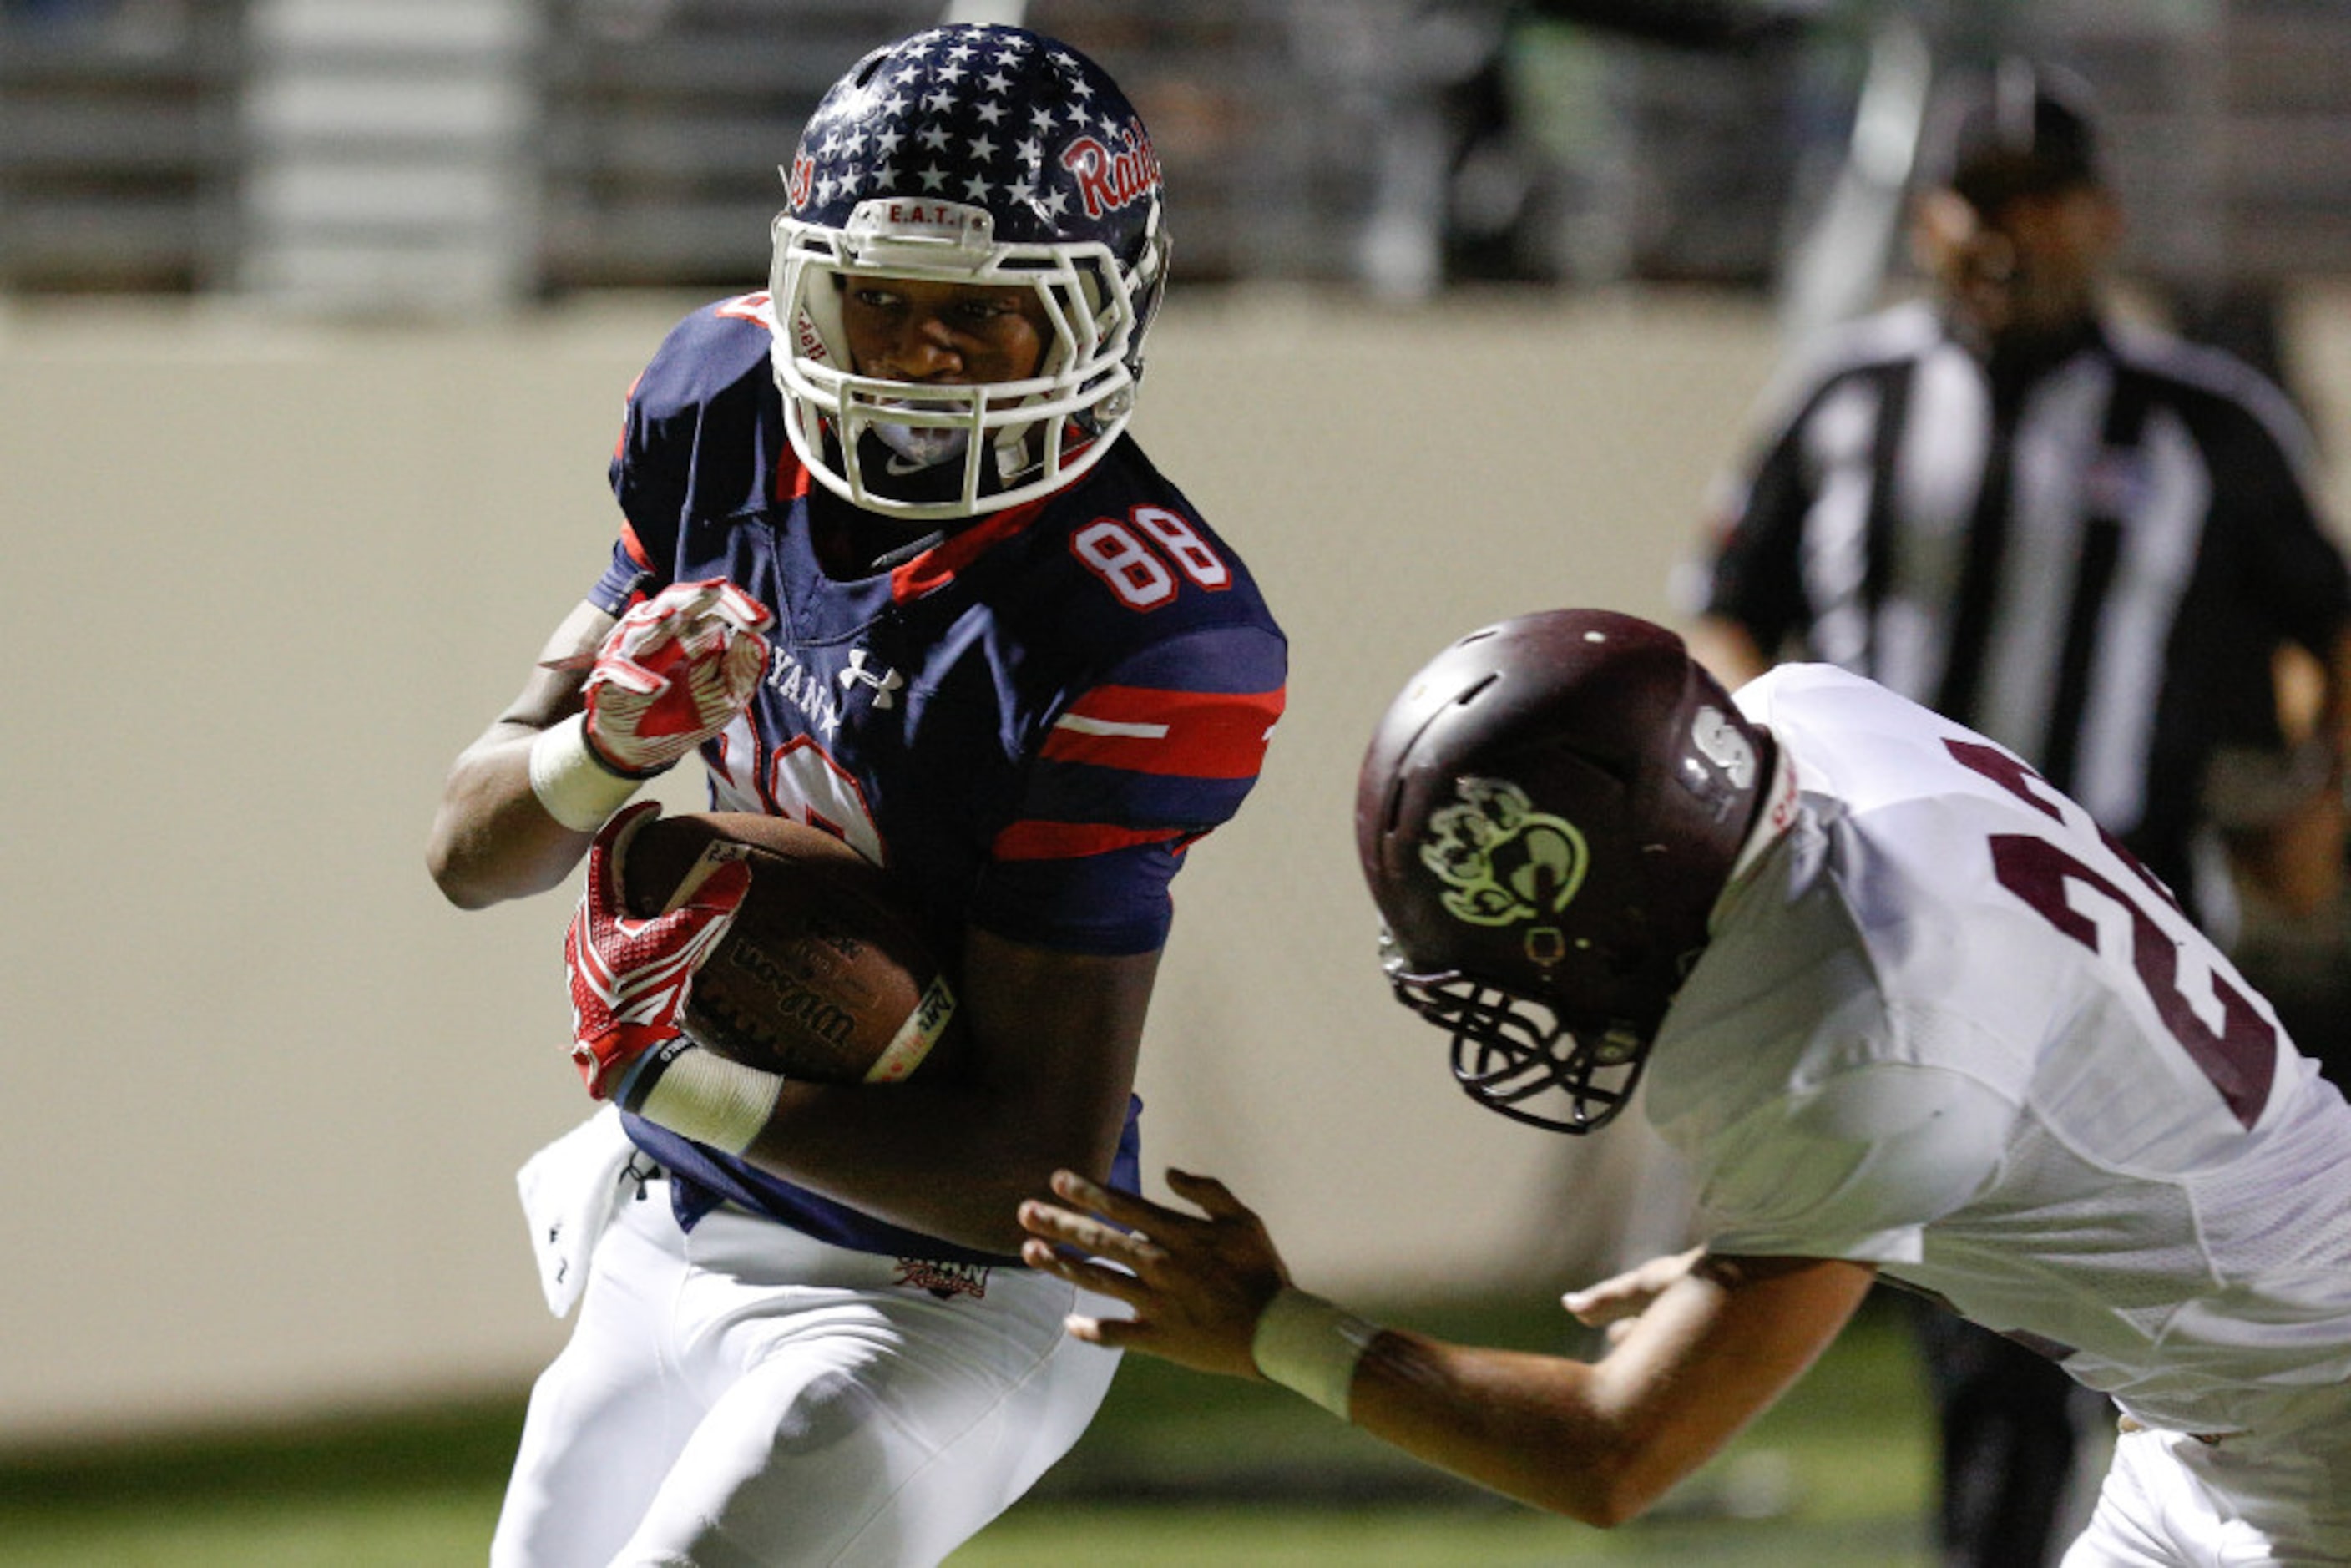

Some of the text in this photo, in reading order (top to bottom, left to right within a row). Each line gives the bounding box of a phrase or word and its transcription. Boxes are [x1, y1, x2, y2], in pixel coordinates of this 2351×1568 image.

[1059, 116, 1163, 220] Raid
[890, 205, 954, 226] E.A.T.
[1069, 503, 1233, 615] 88
[767, 645, 827, 722] YAN
